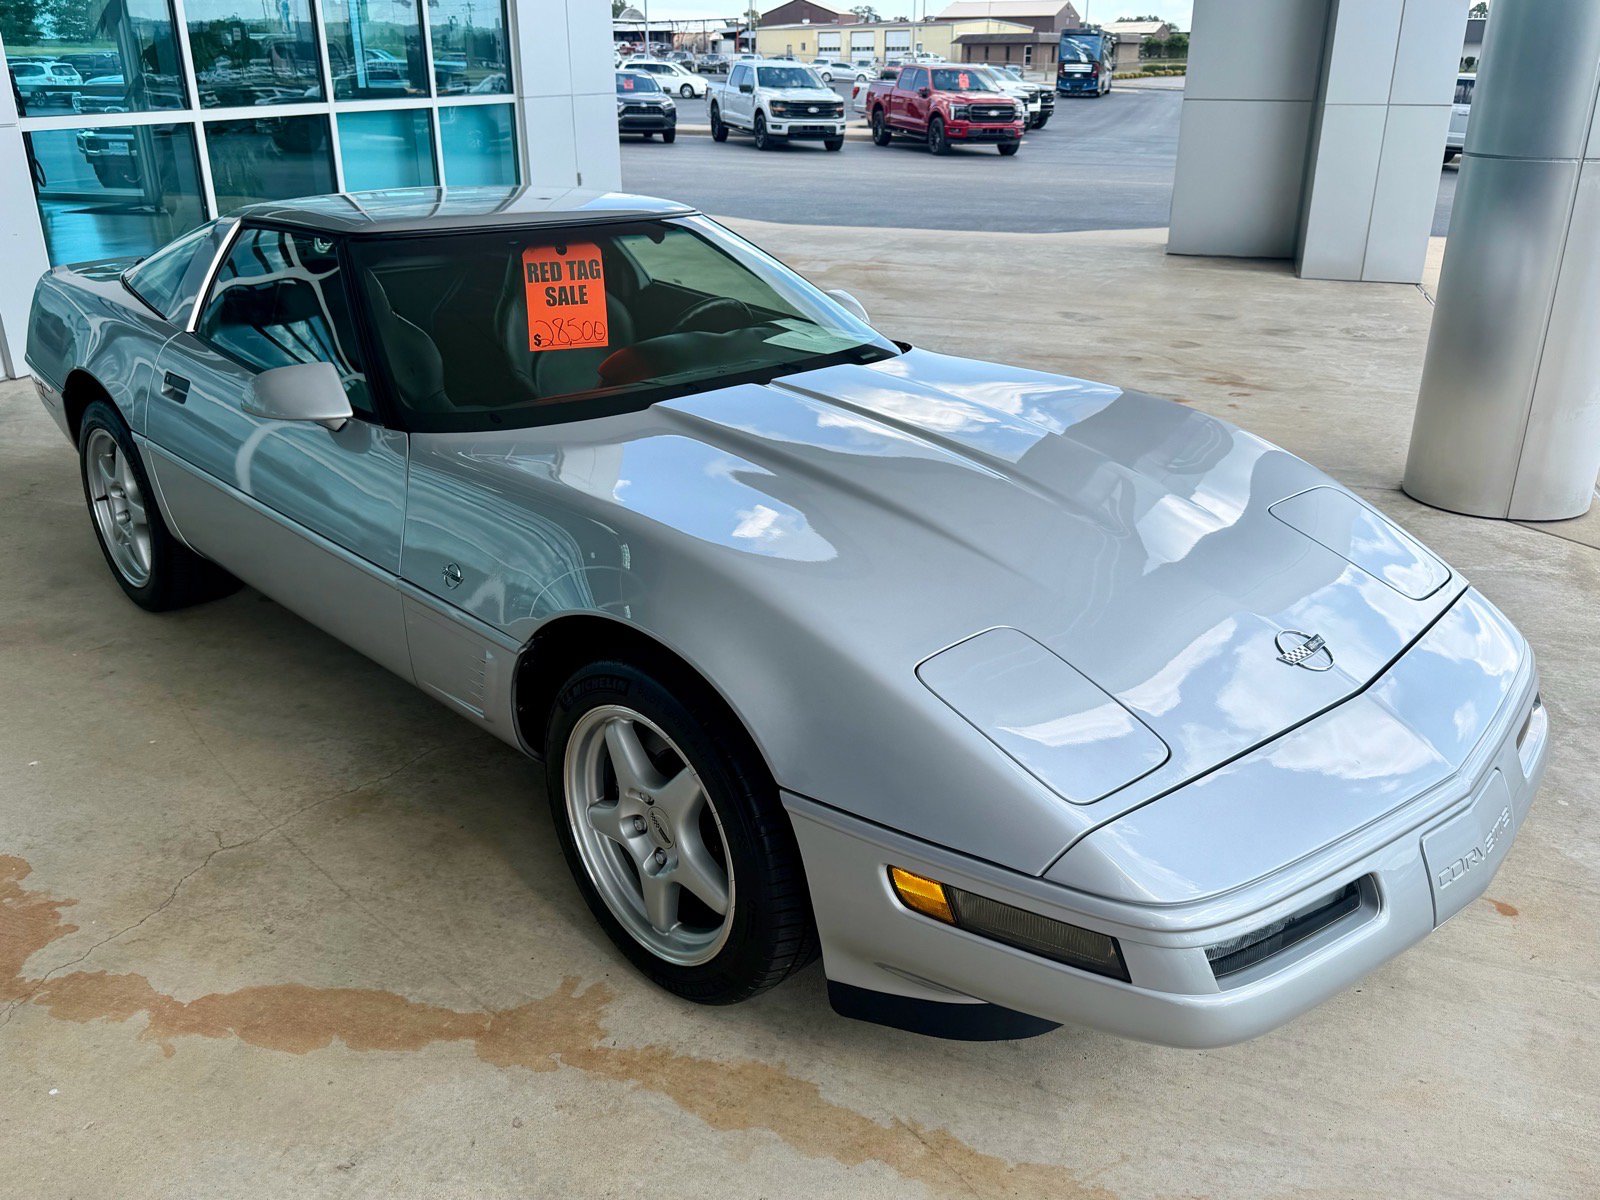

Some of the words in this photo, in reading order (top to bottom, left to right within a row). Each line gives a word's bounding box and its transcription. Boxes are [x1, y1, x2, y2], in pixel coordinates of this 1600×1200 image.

[526, 261, 563, 283] RED
[566, 259, 601, 281] TAG
[545, 285, 588, 307] SALE
[1438, 805, 1510, 890] CORVETTE
